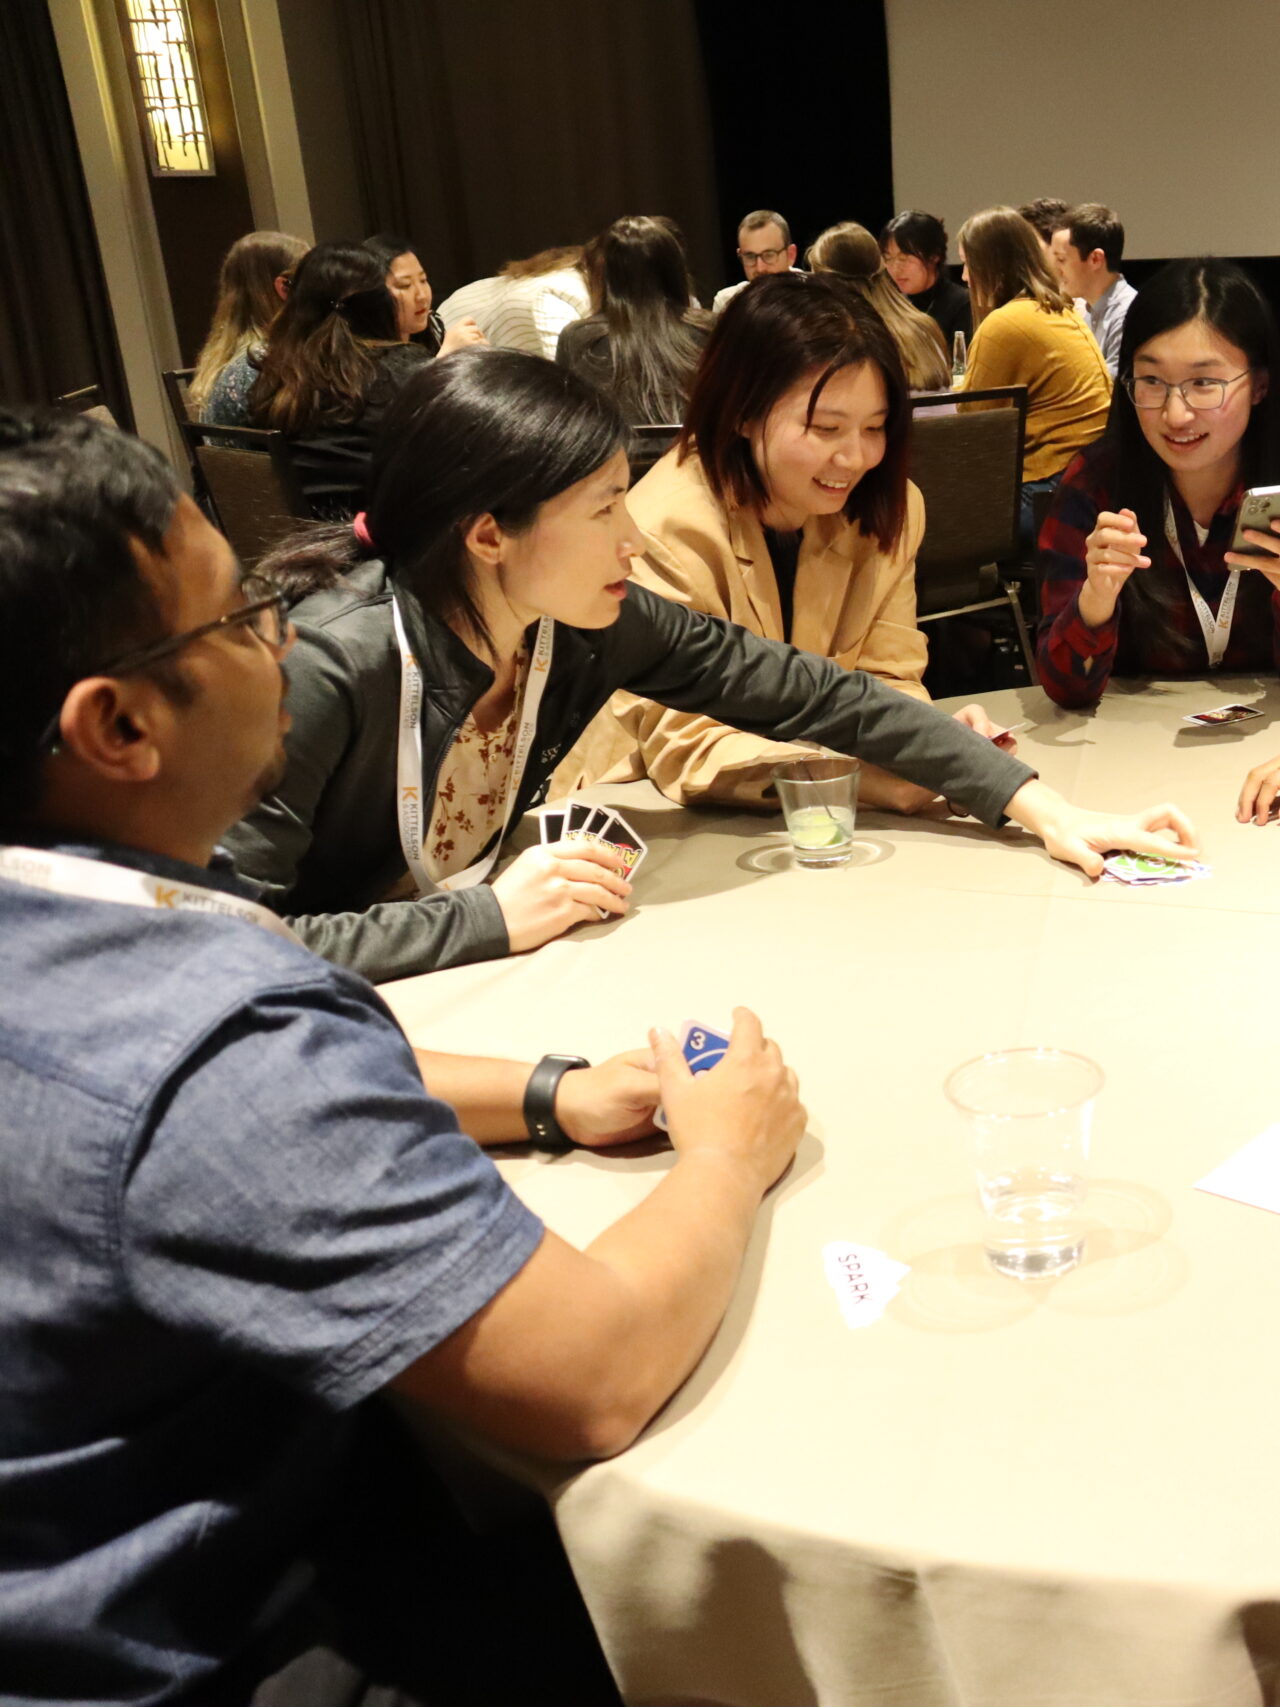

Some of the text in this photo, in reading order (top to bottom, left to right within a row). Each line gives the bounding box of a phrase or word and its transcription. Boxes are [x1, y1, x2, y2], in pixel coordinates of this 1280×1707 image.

[409, 803, 420, 860] KITTELSON
[690, 1031, 707, 1051] 3
[838, 1253, 873, 1305] SPARK
